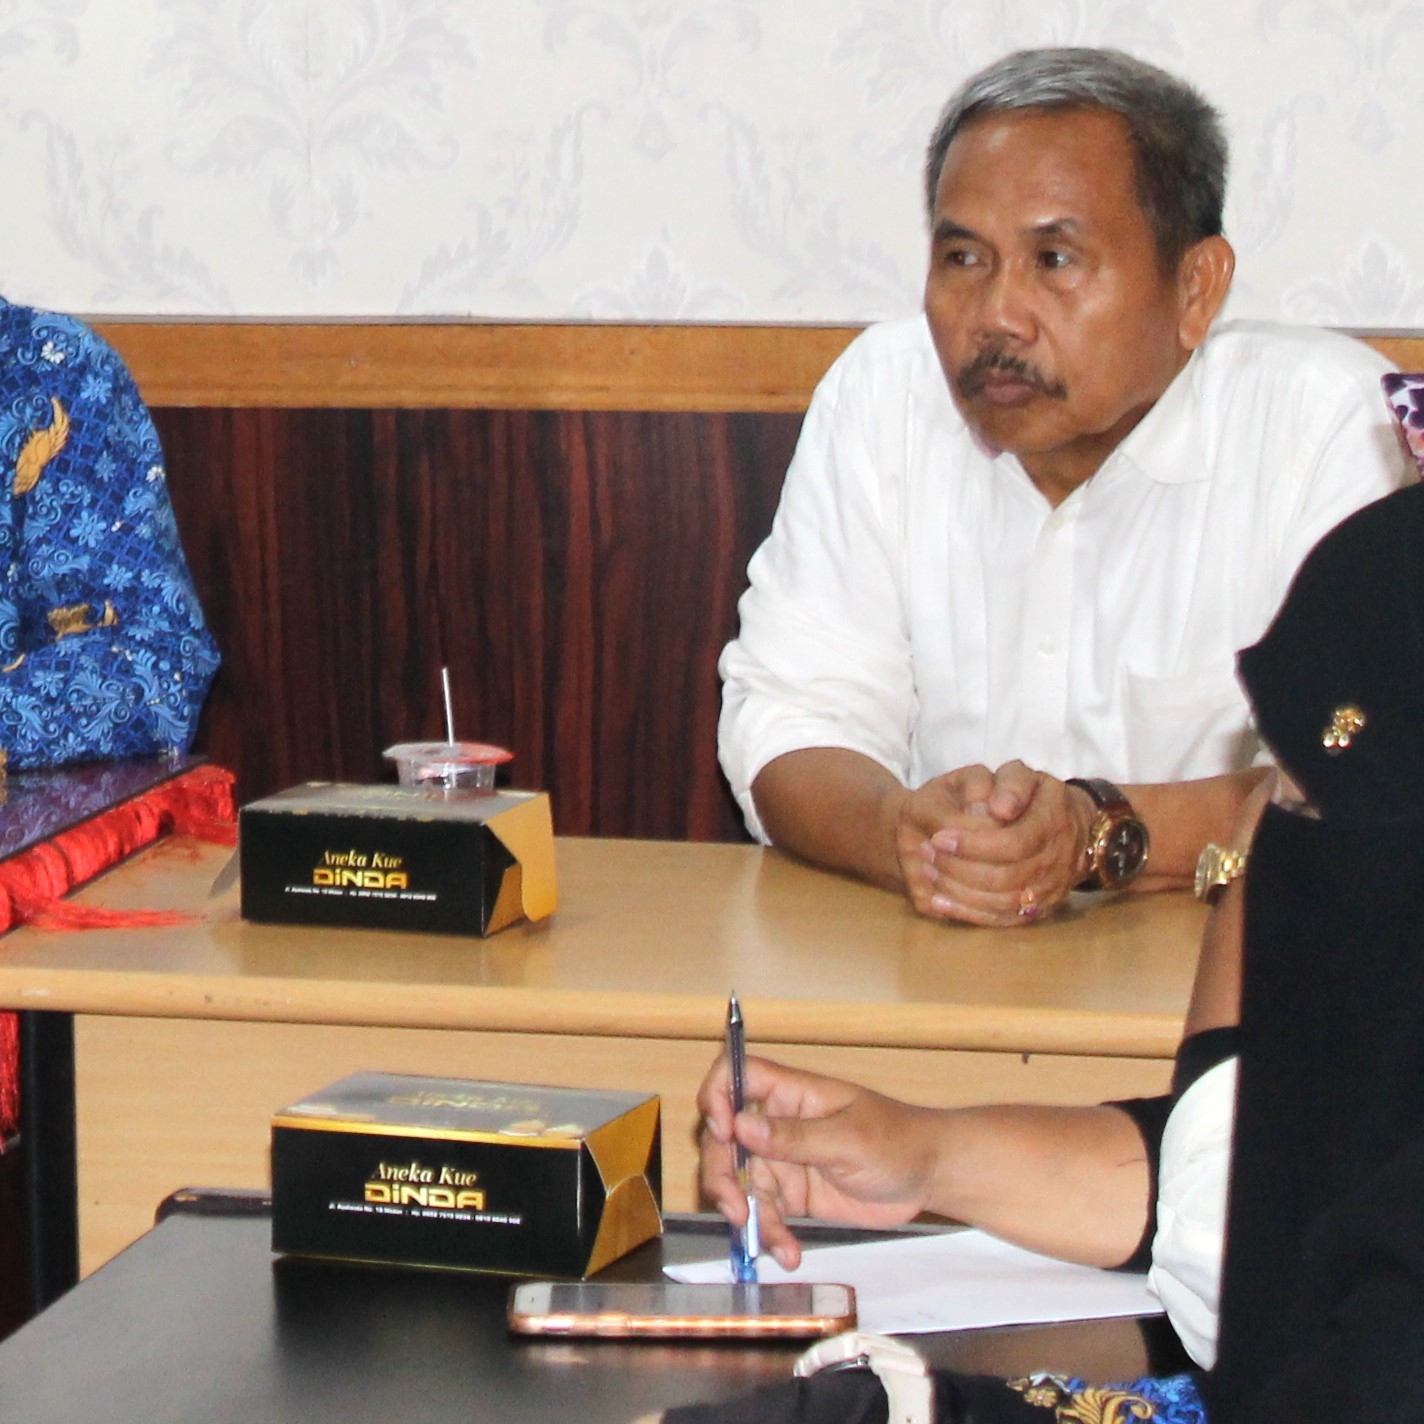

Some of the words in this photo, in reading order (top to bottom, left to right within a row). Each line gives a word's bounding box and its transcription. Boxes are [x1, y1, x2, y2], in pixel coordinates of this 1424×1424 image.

[320, 849, 368, 868] Aneka
[372, 851, 403, 869] Kue
[372, 1161, 433, 1183] Aneka
[439, 1166, 478, 1187] Kue
